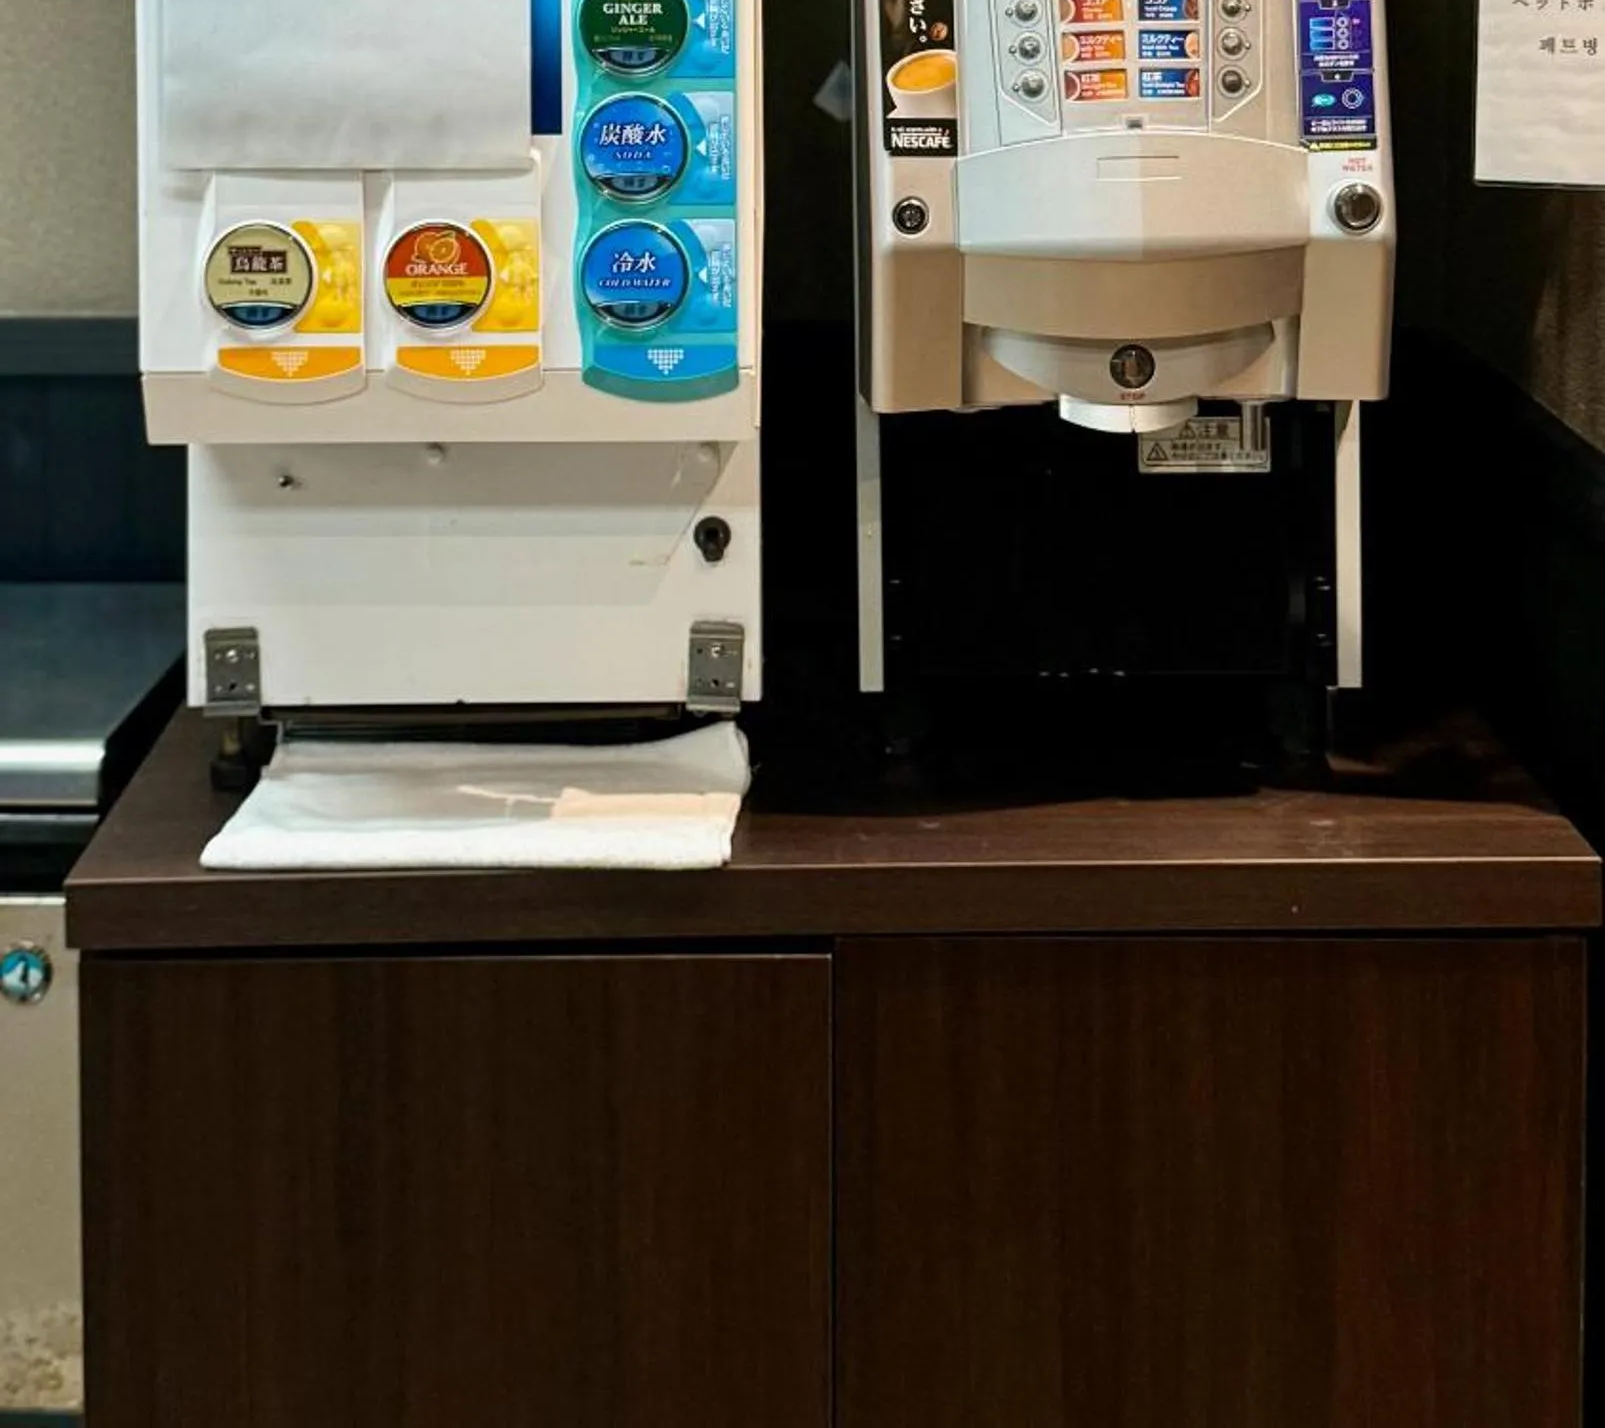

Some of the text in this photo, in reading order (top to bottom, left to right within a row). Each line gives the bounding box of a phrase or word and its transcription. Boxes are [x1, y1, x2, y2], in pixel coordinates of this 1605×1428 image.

[602, 2, 664, 15] GINGER
[618, 14, 649, 26] ALE
[598, 122, 668, 146] 炭酸水
[611, 250, 657, 273] 冷水
[404, 262, 469, 276] ORANGE
